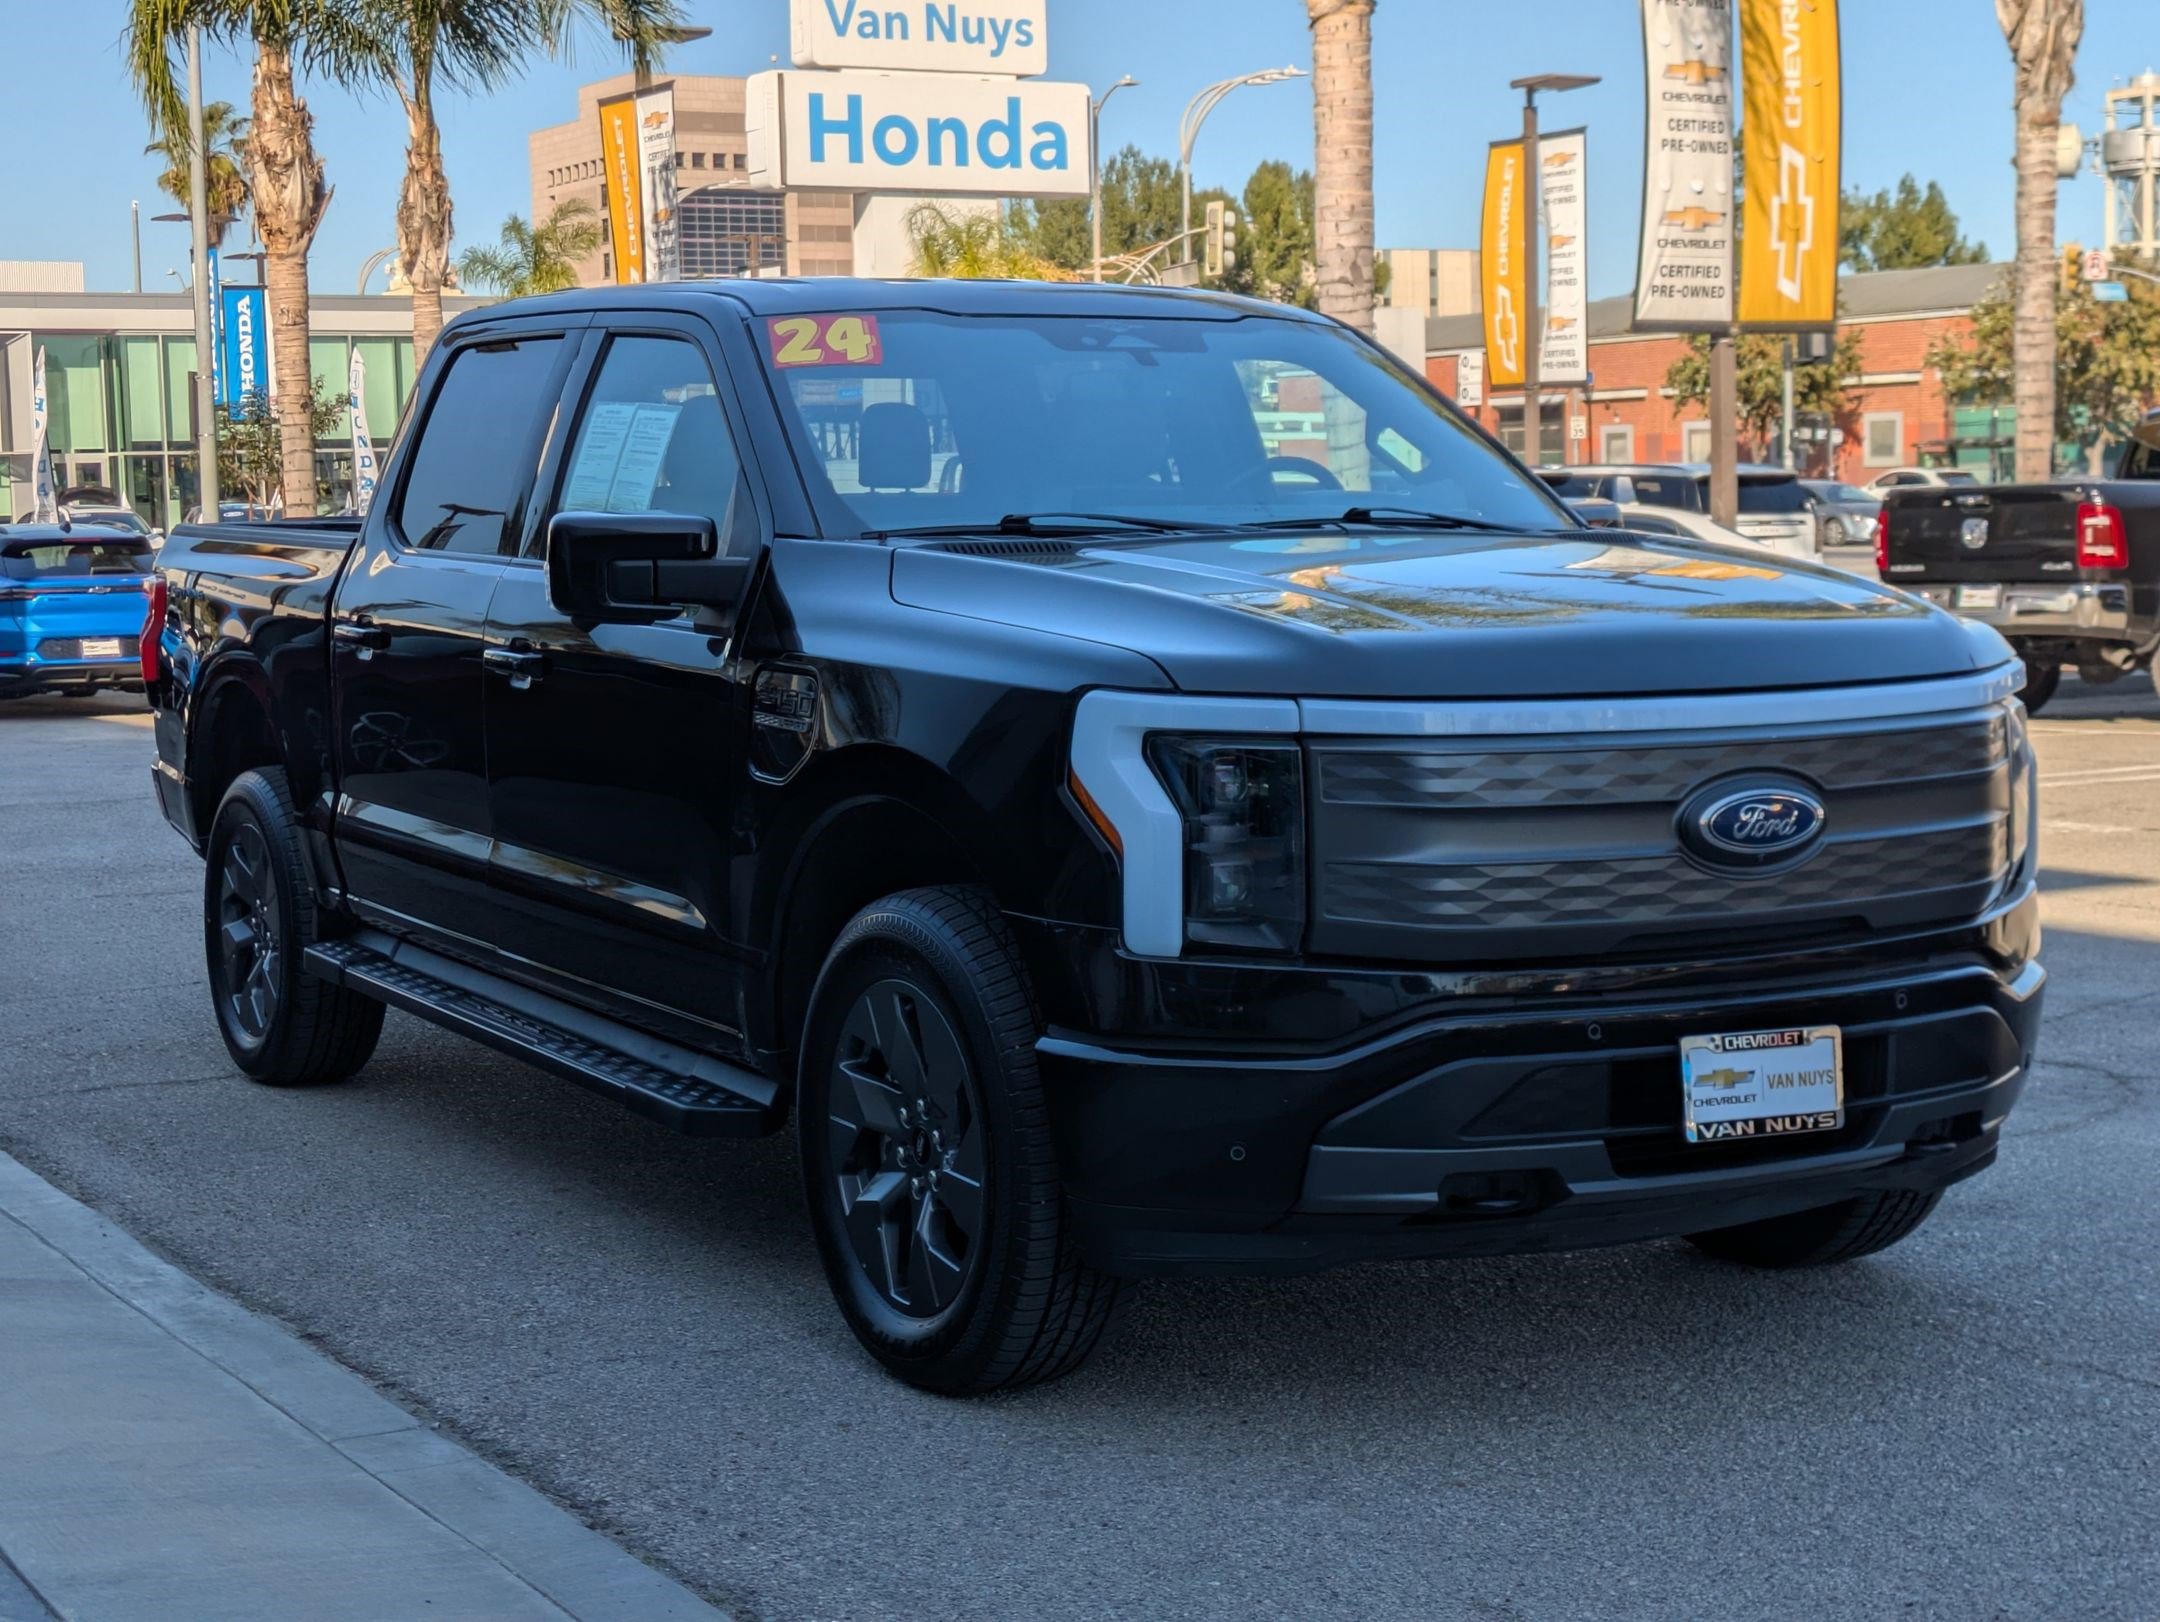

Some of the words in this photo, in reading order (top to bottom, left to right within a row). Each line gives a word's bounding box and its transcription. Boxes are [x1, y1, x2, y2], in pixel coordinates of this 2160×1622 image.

[824, 0, 909, 40] Van
[925, 2, 1034, 57] Nuys
[1781, 0, 1802, 128] CHEVR
[1662, 91, 1728, 104] CHEVROLET
[808, 92, 1068, 170] Honda
[1668, 118, 1725, 134] CERTIFIED
[1660, 138, 1728, 154] PRE-OWNED
[614, 115, 637, 256] CHEVROLET
[1497, 157, 1516, 276] CHEVROLET
[1657, 239, 1727, 249] CHEVROLET
[1660, 264, 1721, 278] CERTIFIED
[1651, 285, 1726, 299] PRE-OWNED
[237, 294, 254, 392] HONDA
[773, 317, 876, 364] 24
[1733, 803, 1799, 840] Ford
[1724, 1031, 1800, 1050] CHEVROLET
[1767, 1073, 1795, 1089] VAN
[1798, 1069, 1835, 1087] NUYS
[1693, 1093, 1758, 1108] CHEVROLET
[1699, 1120, 1755, 1139] VAN
[1765, 1112, 1836, 1134] NUYS
